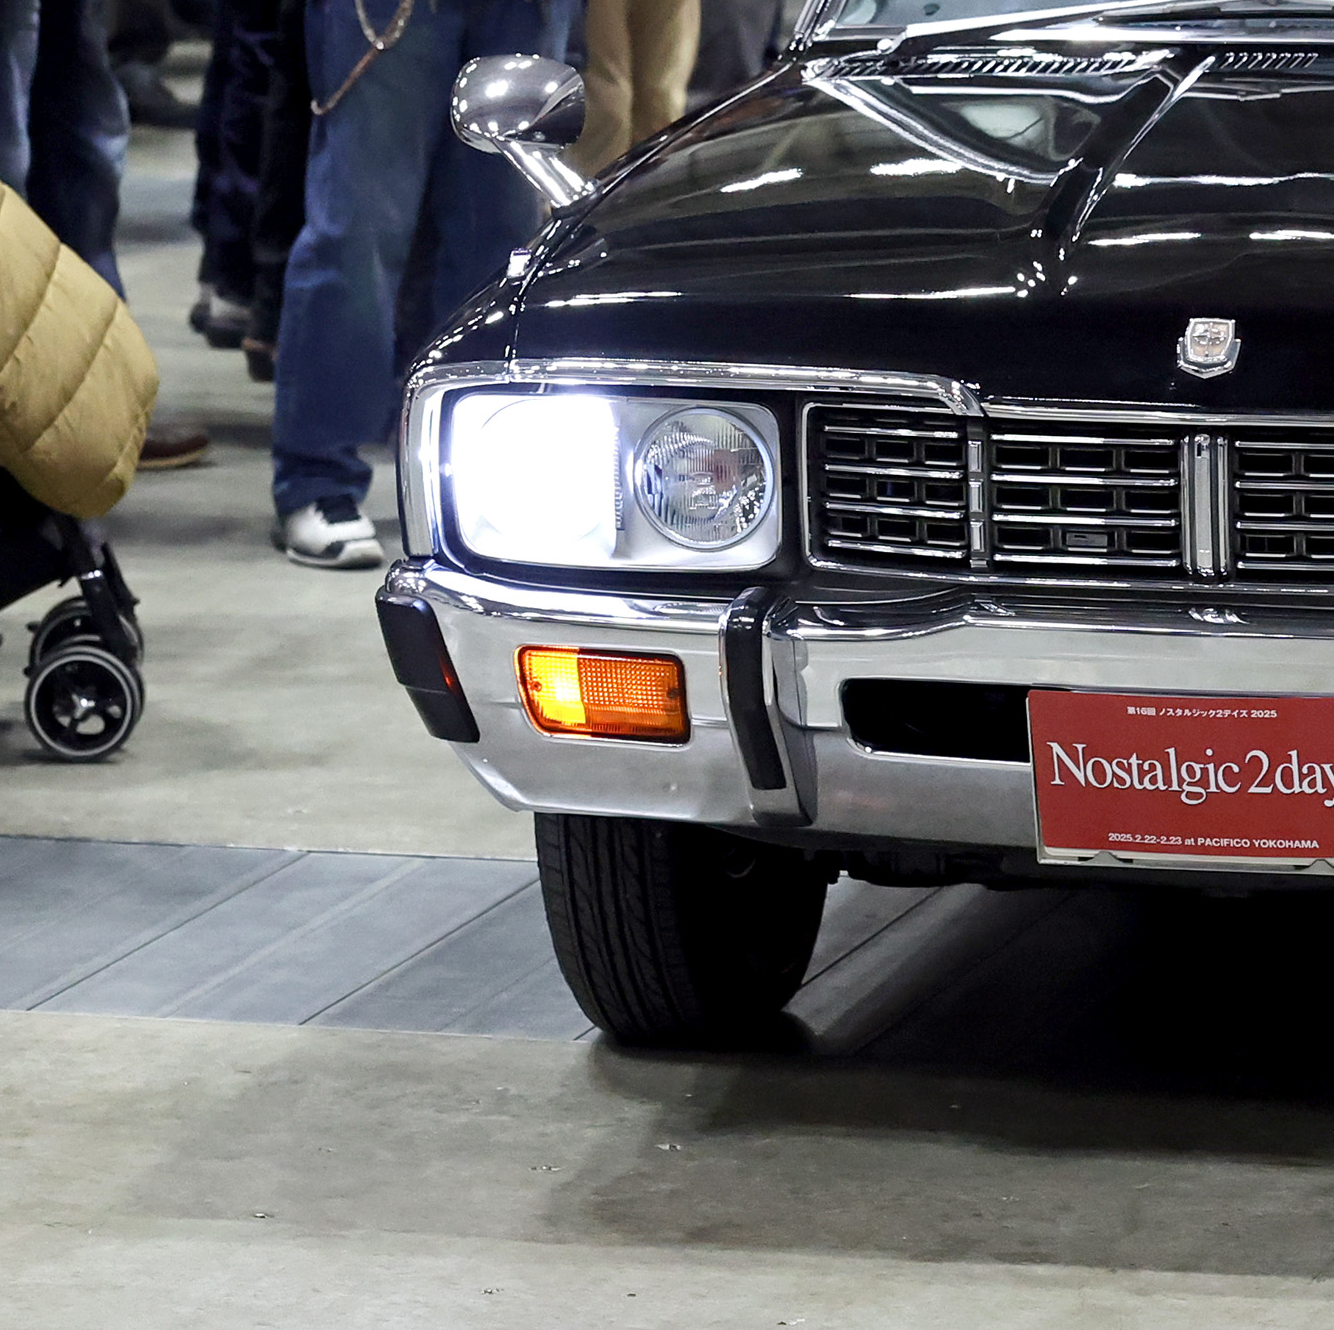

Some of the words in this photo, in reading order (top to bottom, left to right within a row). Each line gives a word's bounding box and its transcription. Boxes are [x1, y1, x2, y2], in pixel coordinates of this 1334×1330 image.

[1250, 709, 1278, 718] 2025
[1046, 741, 1241, 805] Nostalgic
[1184, 838, 1195, 846] at
[1197, 837, 1250, 848] PACIFICO
[1253, 839, 1320, 849] YOKOHAMA
